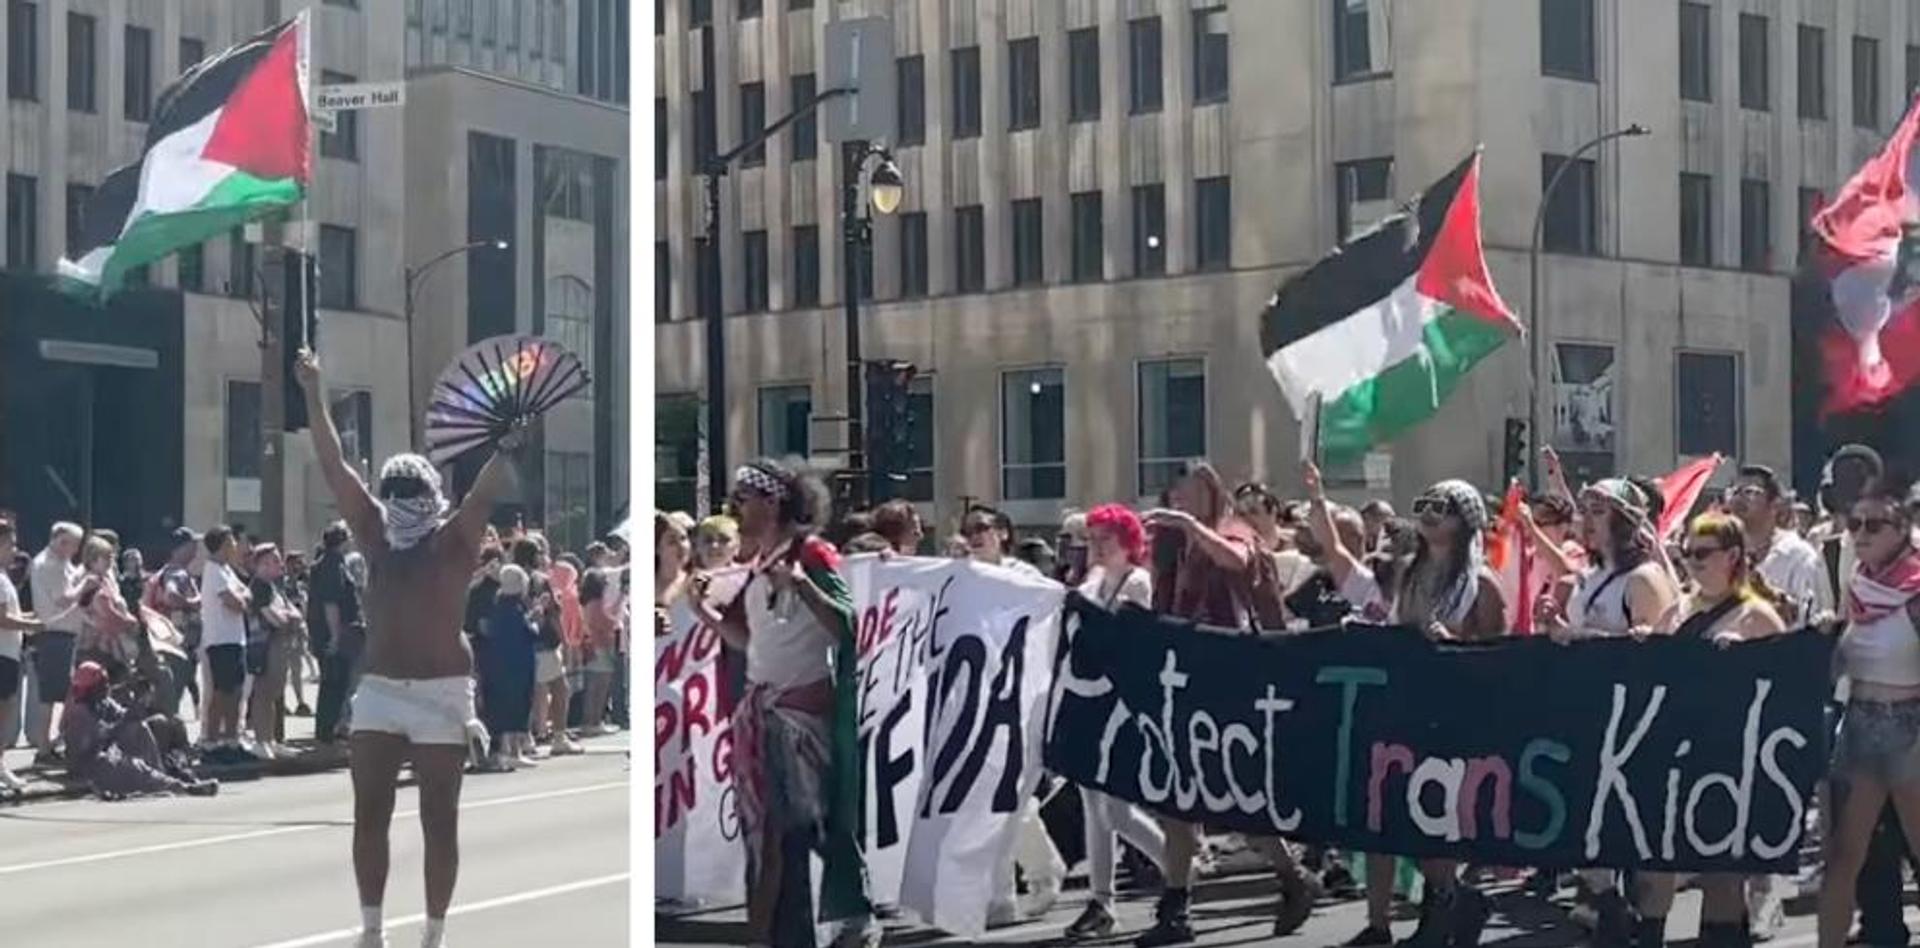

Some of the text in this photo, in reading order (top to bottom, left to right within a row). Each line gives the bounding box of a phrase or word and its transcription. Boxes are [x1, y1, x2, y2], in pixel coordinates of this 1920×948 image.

[318, 90, 399, 108] Beaver Hall
[655, 654, 735, 775] PRI
[1315, 665, 1572, 849] Trans
[1584, 677, 1808, 862] Kids
